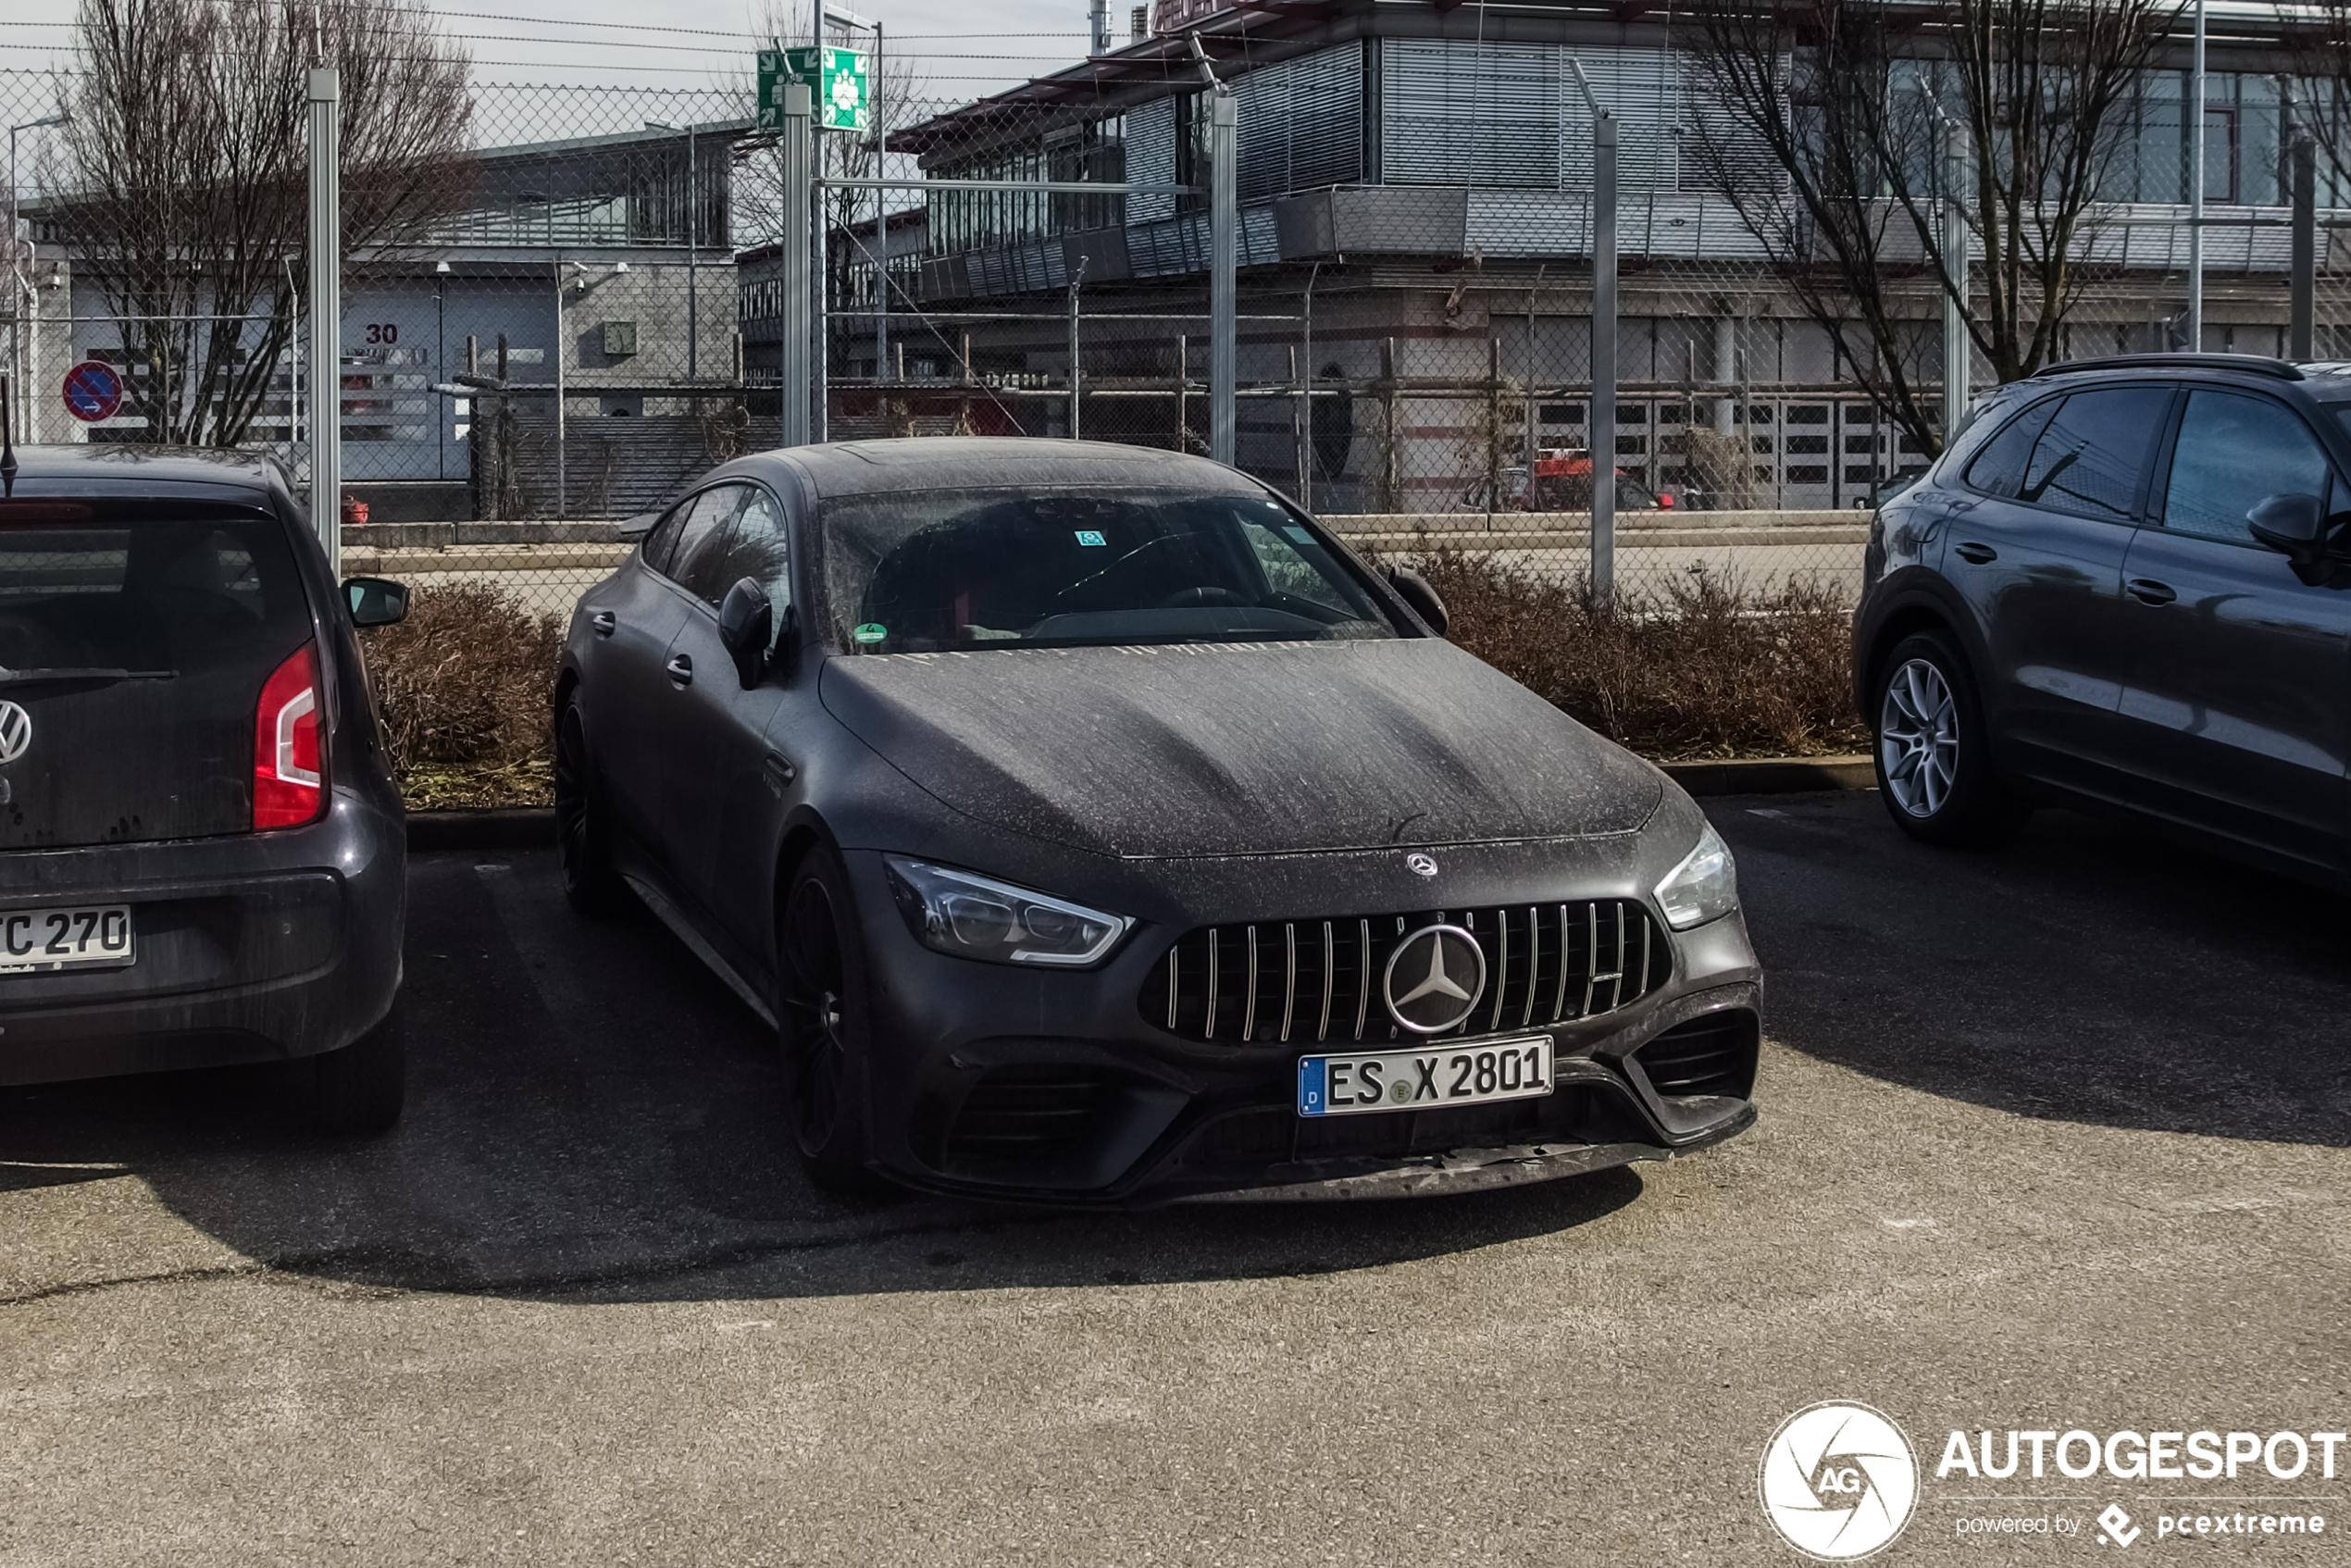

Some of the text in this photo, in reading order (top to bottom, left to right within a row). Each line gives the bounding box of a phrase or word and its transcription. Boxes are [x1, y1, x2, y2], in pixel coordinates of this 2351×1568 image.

[367, 324, 397, 343] 30
[865, 624, 875, 632] 4
[0, 911, 127, 955] C 270
[1328, 1047, 1545, 1105] ES X 2801
[1308, 1092, 1318, 1104] D
